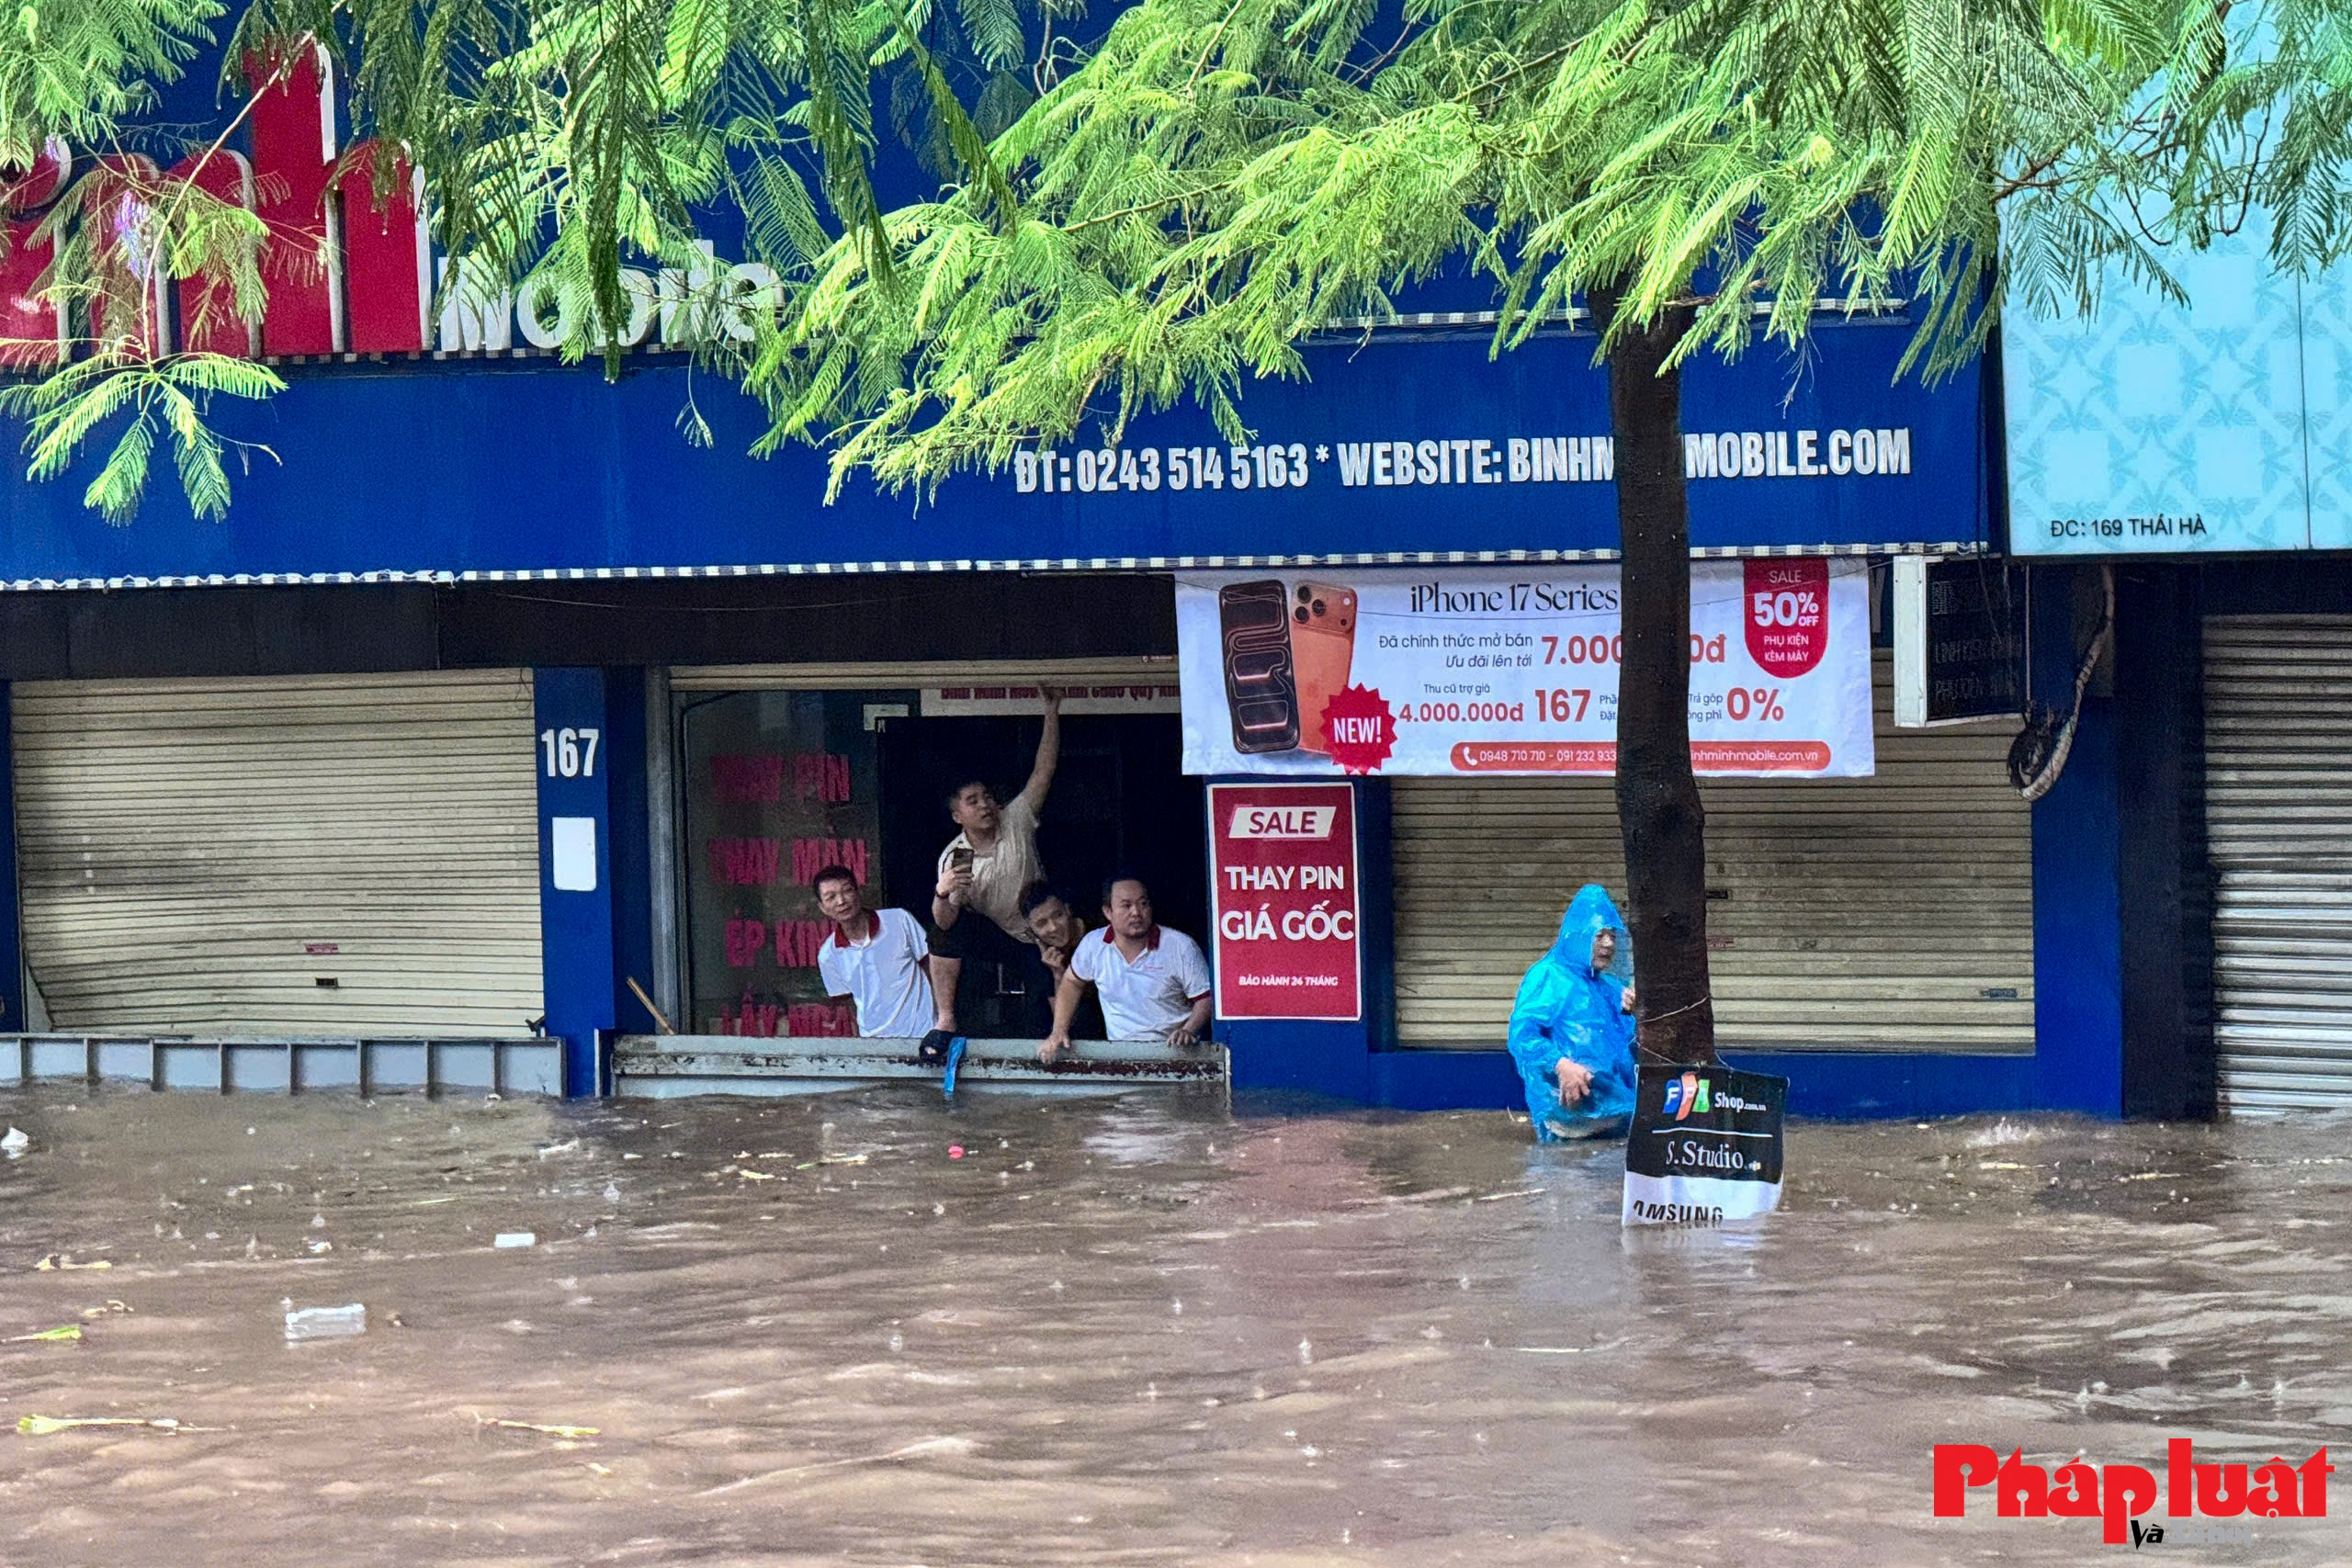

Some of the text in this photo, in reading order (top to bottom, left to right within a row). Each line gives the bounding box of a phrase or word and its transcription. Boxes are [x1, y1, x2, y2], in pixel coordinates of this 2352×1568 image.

[1014, 427, 1911, 493] ĐT: 0243 514 5163 WEBSITE: BINHMMOBILE.COM
[2050, 513, 2207, 537] ĐC: 169 THÁI HÀ
[1769, 570, 1803, 583] SALE
[1410, 581, 1619, 613] iPhone 17 Series
[1754, 592, 1819, 626] 50%
[1798, 615, 1818, 626] OFF
[1379, 635, 1397, 649] Đã
[1401, 634, 1440, 649] chính
[1442, 633, 1476, 648] thức
[1478, 632, 1501, 647] mở
[1505, 632, 1533, 647] bán
[1764, 632, 1809, 648] PHỤ KIỆN
[1445, 654, 1532, 668] Ưu đãi lên tới
[1424, 683, 1490, 696] Thu cũ trợ giá
[1599, 694, 1618, 705] Phầ
[1703, 693, 1724, 705] góp
[1399, 703, 1524, 723] 4.000.000đ
[1534, 688, 1591, 723] 167
[1727, 687, 1784, 721] 0%
[1333, 716, 1382, 744] NEW!
[541, 728, 599, 777] 167
[1479, 750, 1509, 762] 0948
[1510, 750, 1528, 761] 710
[1530, 750, 1546, 761] 710
[1556, 750, 1574, 761] 091
[1576, 750, 1595, 761] 232
[1597, 750, 1617, 761] 933
[1690, 749, 1819, 762] inhminhmobile.com.vn
[1249, 810, 1317, 834] SALE
[1225, 866, 1344, 890] THAY PIN
[1220, 899, 1354, 941] GIÁ GỐC
[775, 905, 838, 967] KÍN
[1238, 974, 1338, 986] BẢO HÀNH 24 THÁNG
[1662, 1071, 1710, 1121] FPT
[1633, 1200, 1724, 1223] AMSUNG
